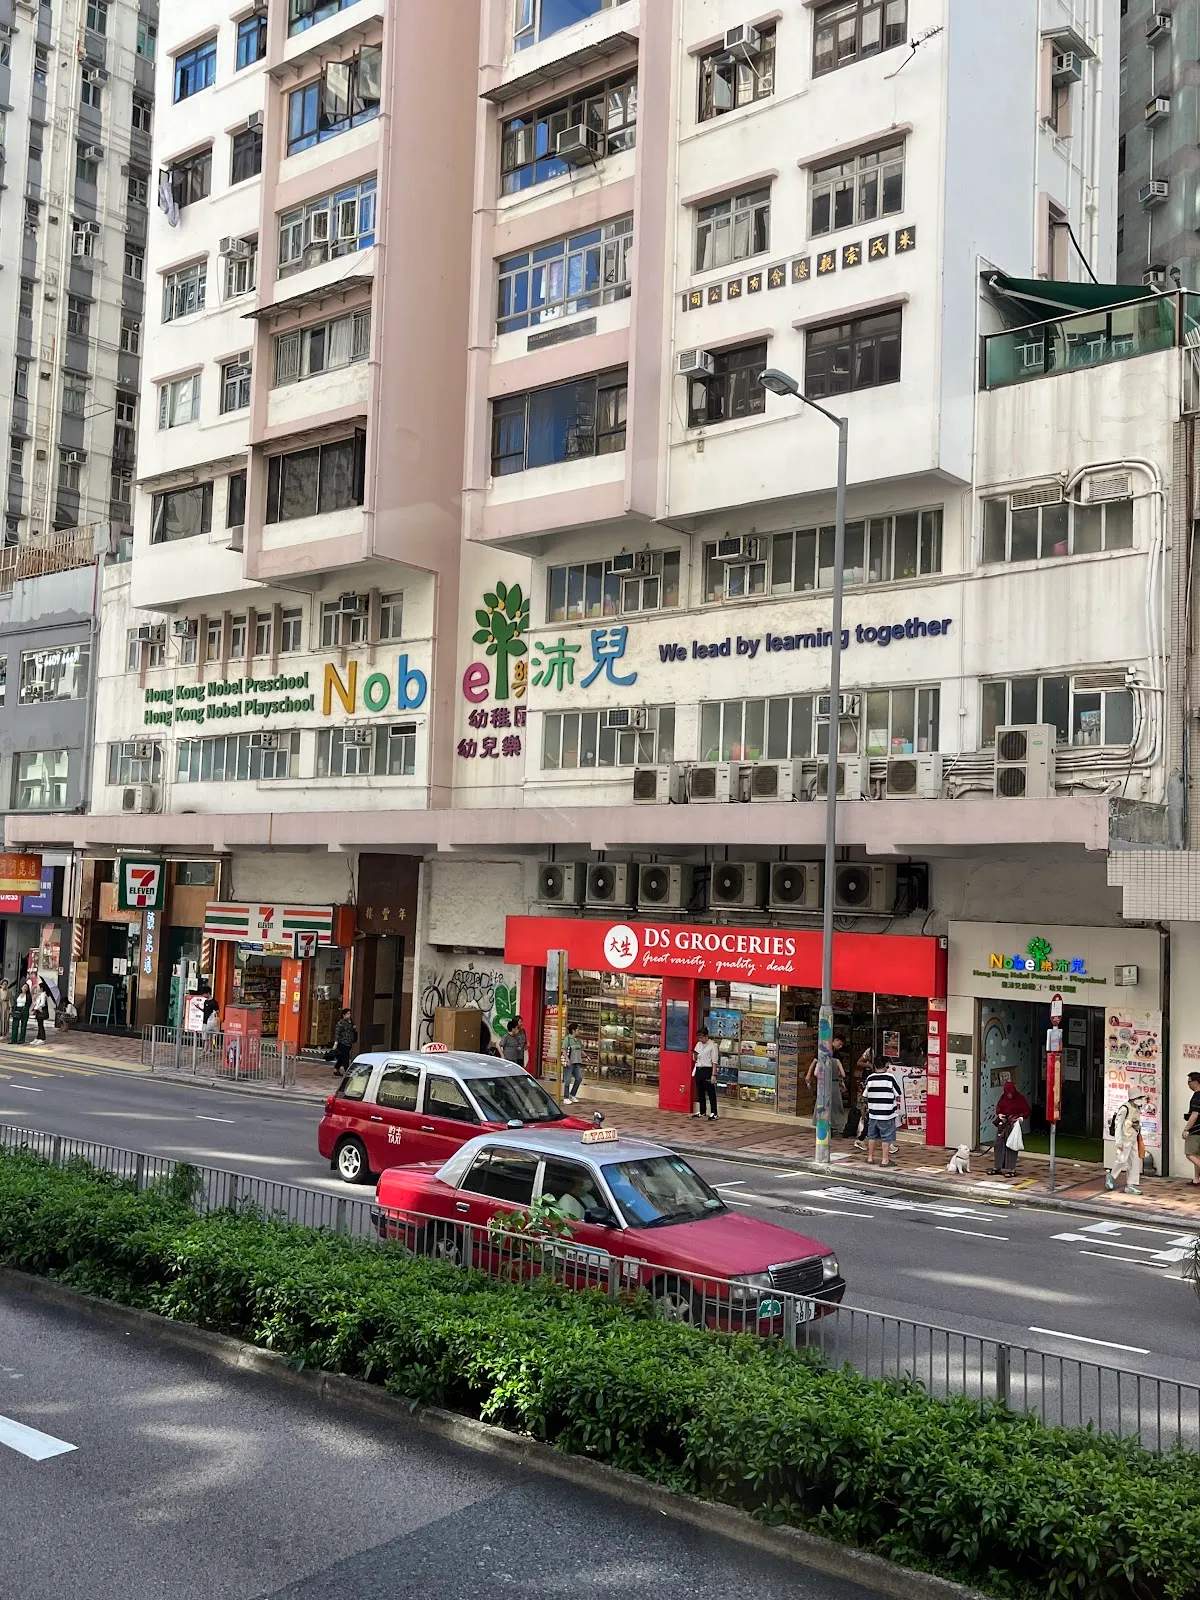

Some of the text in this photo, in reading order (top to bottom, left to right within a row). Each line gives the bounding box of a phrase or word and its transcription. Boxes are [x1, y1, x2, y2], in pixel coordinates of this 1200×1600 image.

[659, 617, 952, 662] We lead by learning together
[144, 671, 309, 704] Hong Kong Nobel Preschool
[143, 694, 315, 726] Hong Kong Nobel Playschool
[609, 935, 633, 958] 大生
[643, 928, 797, 956] DS GROCERIES
[642, 950, 795, 977] Great variety quality deals
[429, 1043, 447, 1052] TAXI
[388, 1125, 403, 1135] 的士
[388, 1134, 402, 1145] TAXI
[590, 1130, 617, 1141] TAXI
